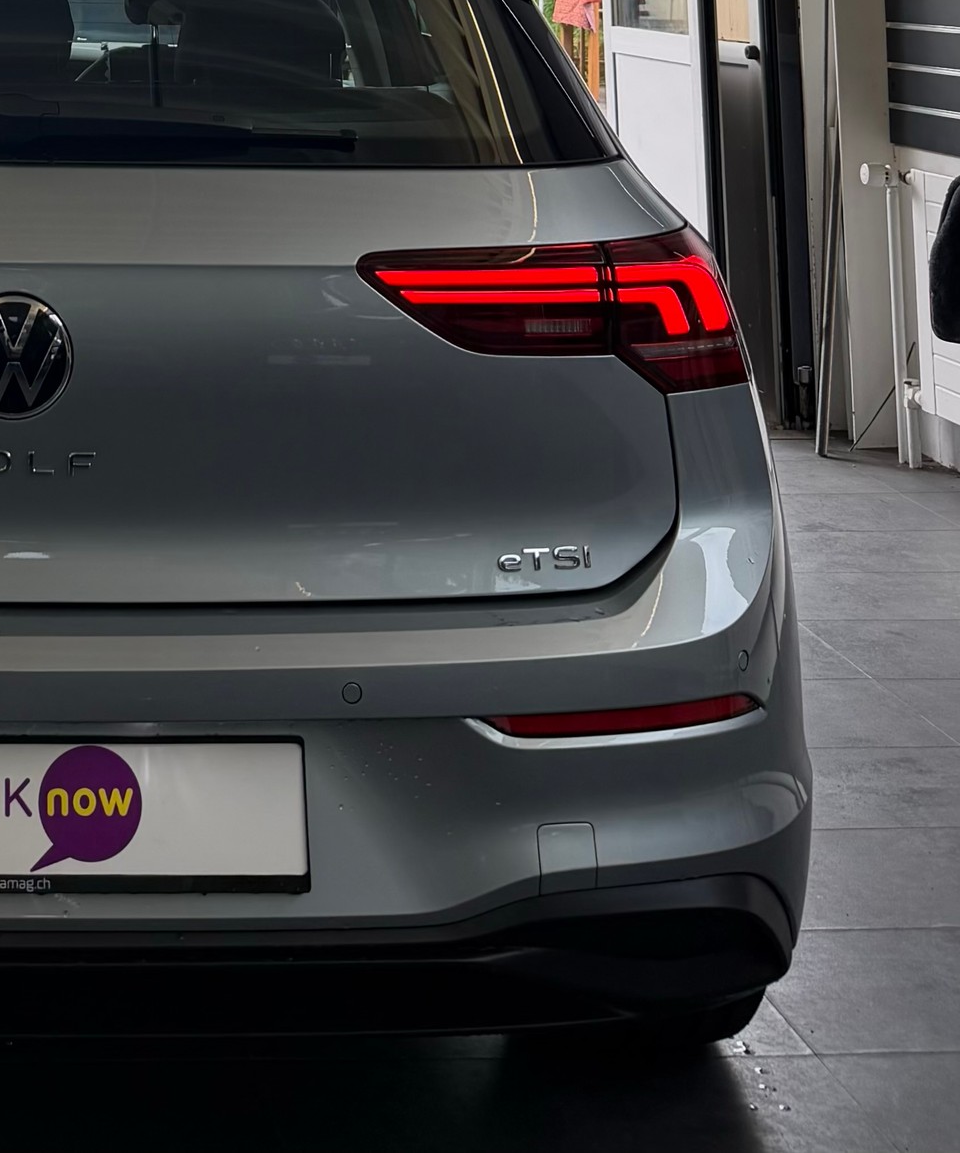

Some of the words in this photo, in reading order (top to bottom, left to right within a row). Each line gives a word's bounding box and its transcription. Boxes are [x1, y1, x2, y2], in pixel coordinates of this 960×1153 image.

[497, 544, 592, 573] eTSI
[46, 786, 134, 817] now
[0, 877, 51, 892] amag.ch
